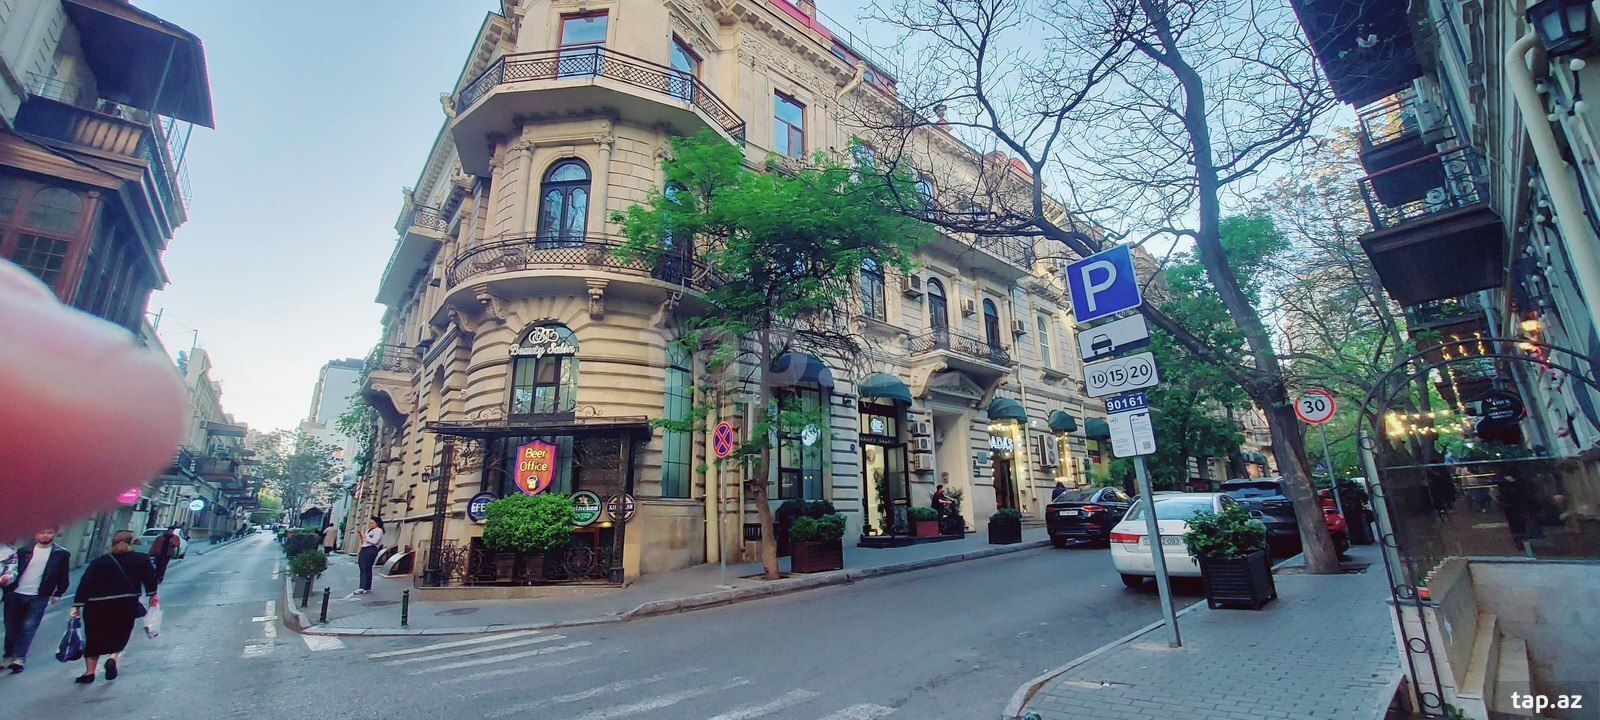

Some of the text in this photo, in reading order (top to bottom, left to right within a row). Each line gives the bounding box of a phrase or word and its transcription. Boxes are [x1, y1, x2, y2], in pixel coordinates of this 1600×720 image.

[1081, 260, 1117, 312] P
[509, 342, 576, 359] Beauty Salon
[1092, 364, 1149, 385] 10 15 20
[1106, 395, 1143, 411] 90161
[1303, 399, 1325, 414] 30
[525, 447, 547, 459] Beer
[519, 460, 548, 471] Office
